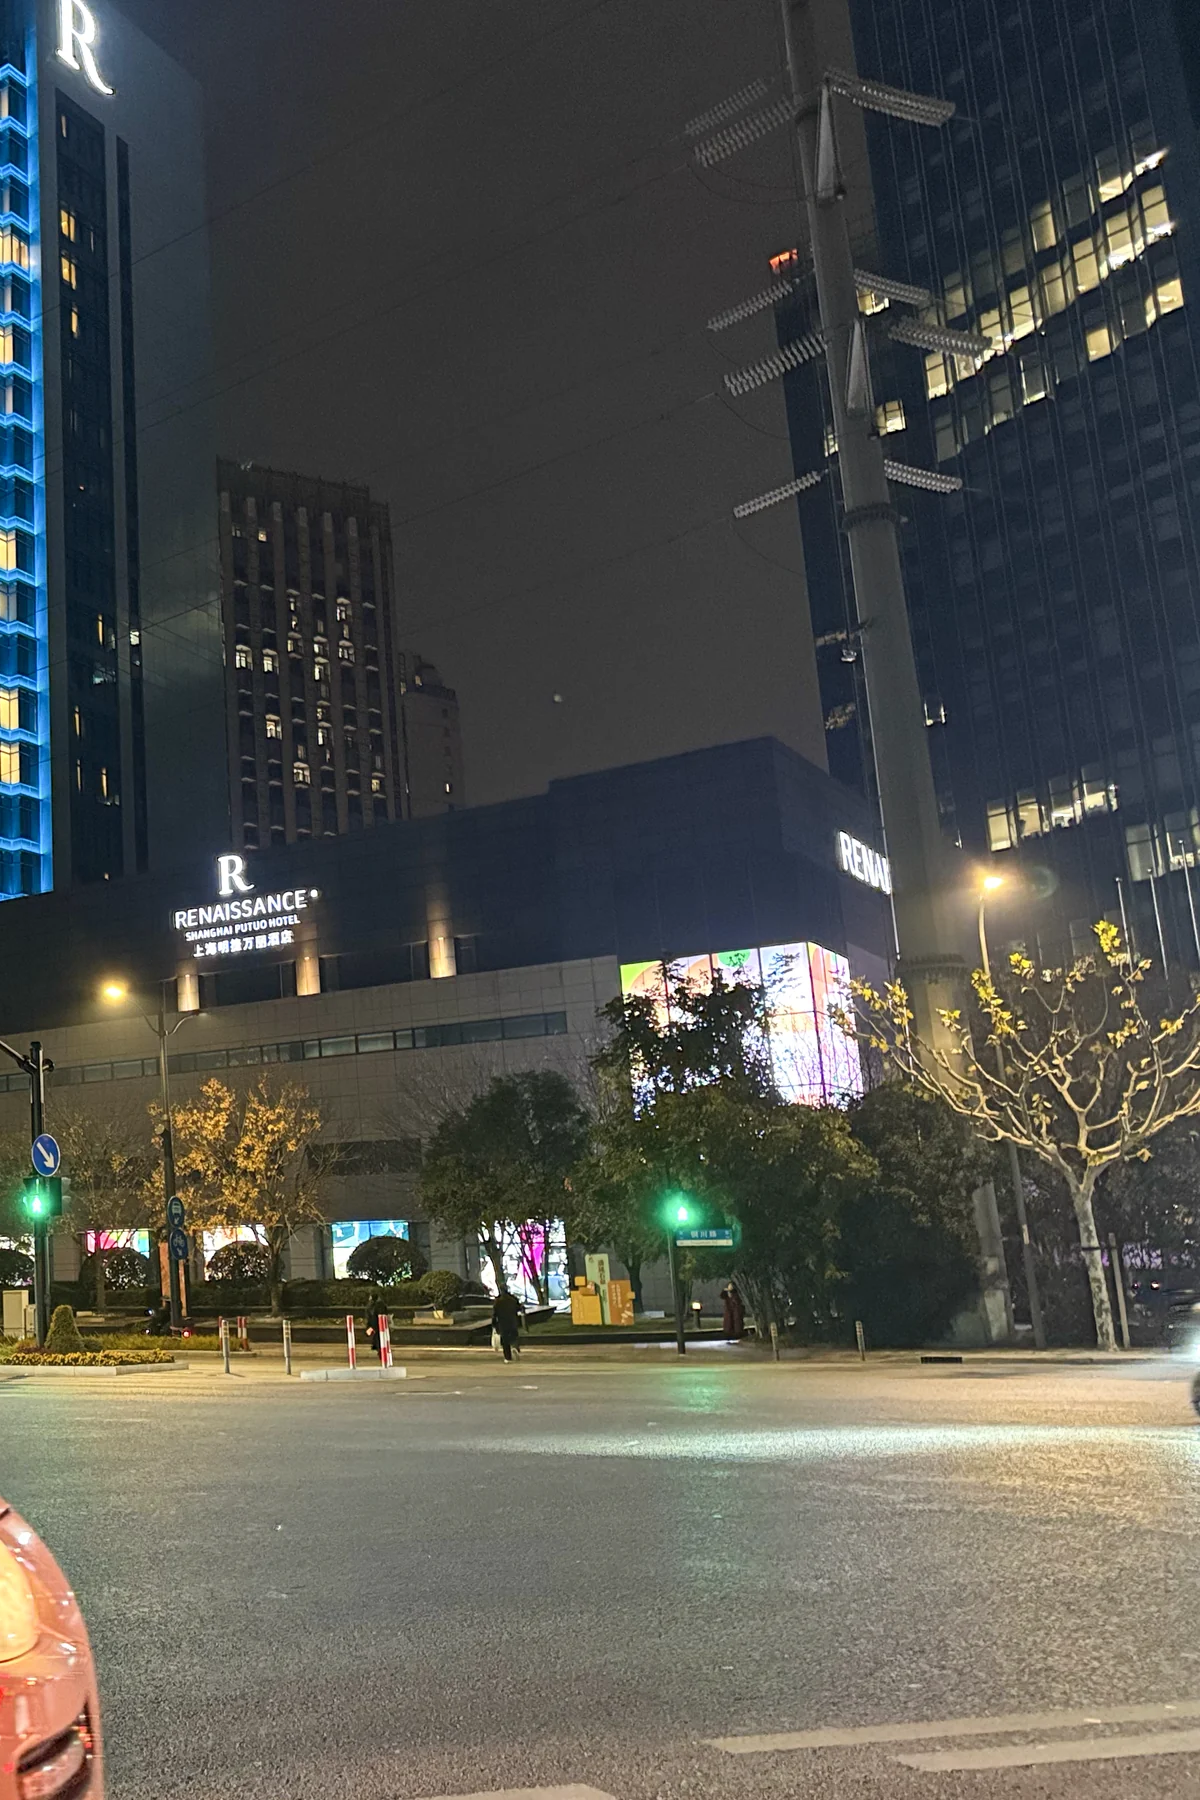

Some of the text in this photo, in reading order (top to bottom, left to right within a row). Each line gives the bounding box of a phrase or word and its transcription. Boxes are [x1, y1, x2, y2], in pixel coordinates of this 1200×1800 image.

[57, 0, 114, 95] R
[217, 855, 255, 896] R
[175, 889, 308, 929] RENAISSANCE
[185, 914, 301, 942] SHANGHAI PUTUO HOTEL
